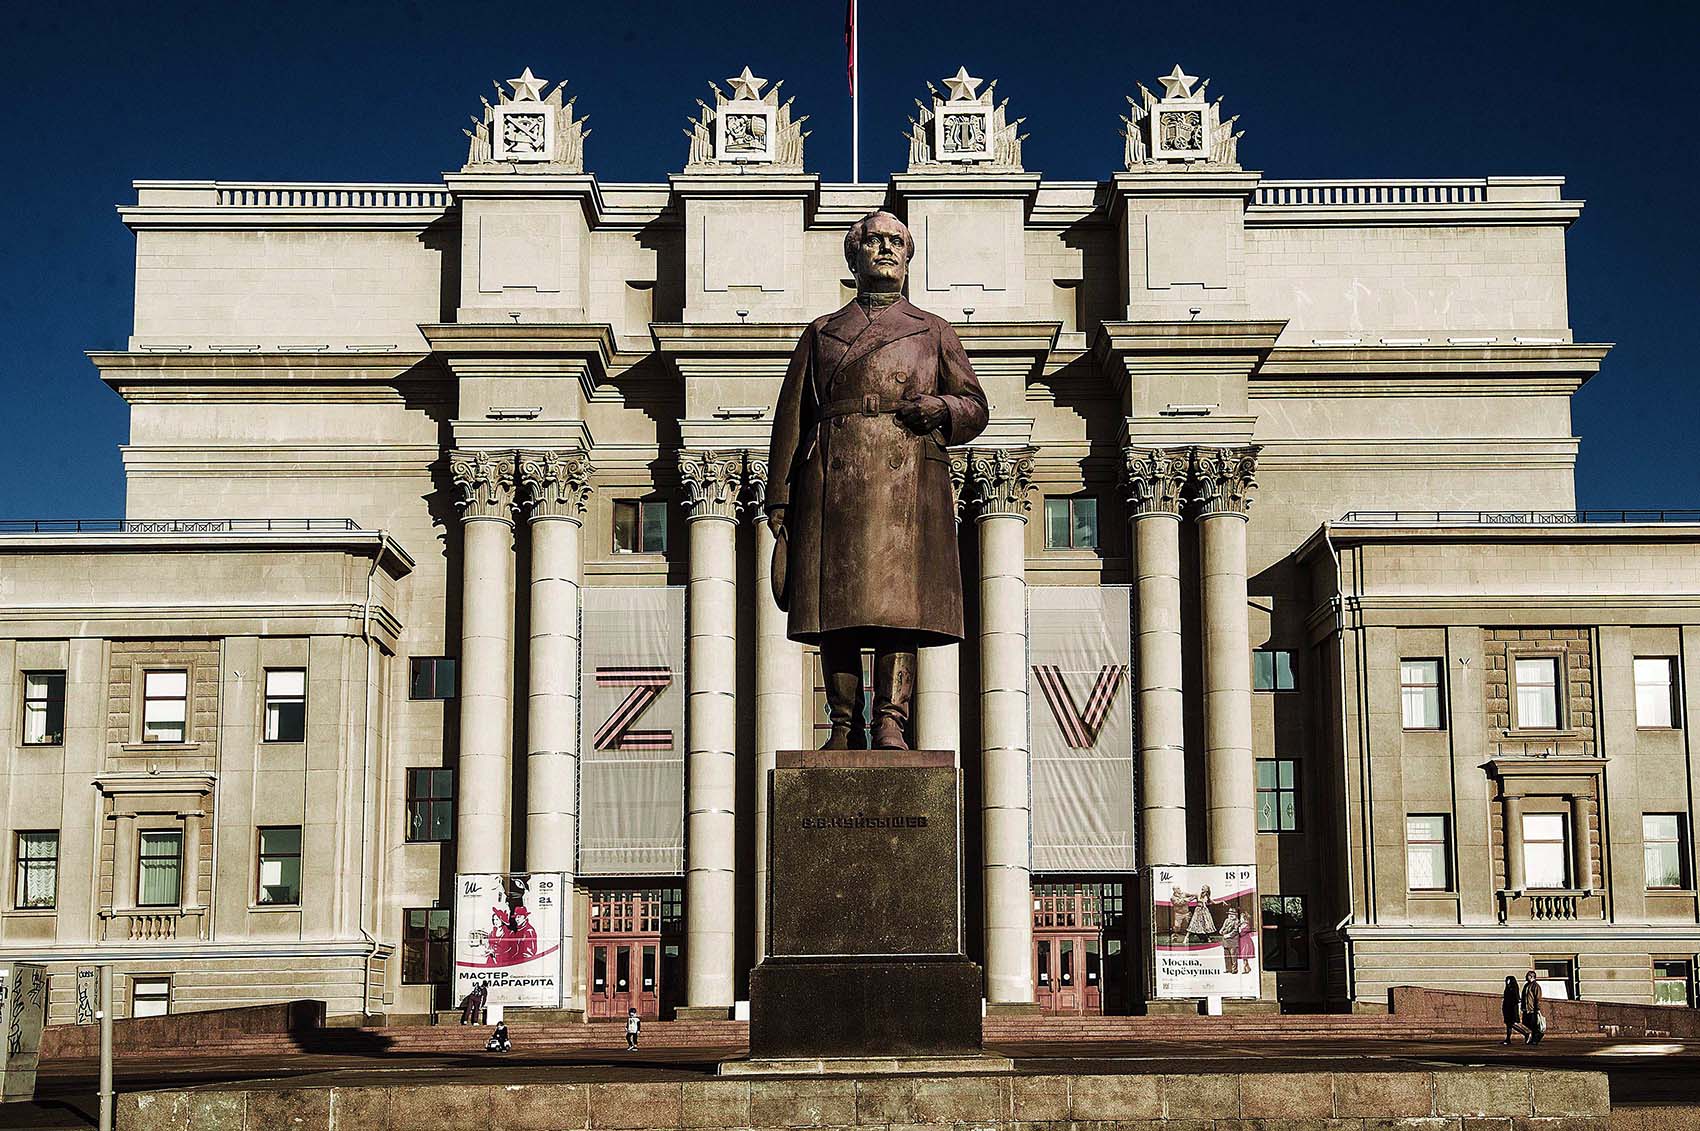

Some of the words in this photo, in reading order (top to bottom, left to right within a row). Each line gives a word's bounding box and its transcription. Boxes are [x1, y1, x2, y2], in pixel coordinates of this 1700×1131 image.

[593, 666, 672, 750] Z
[1031, 665, 1129, 748] V
[1225, 871, 1236, 880] 18
[1240, 871, 1250, 880] 19
[1162, 958, 1202, 966] Москва,
[1162, 967, 1220, 977] Черёмушки
